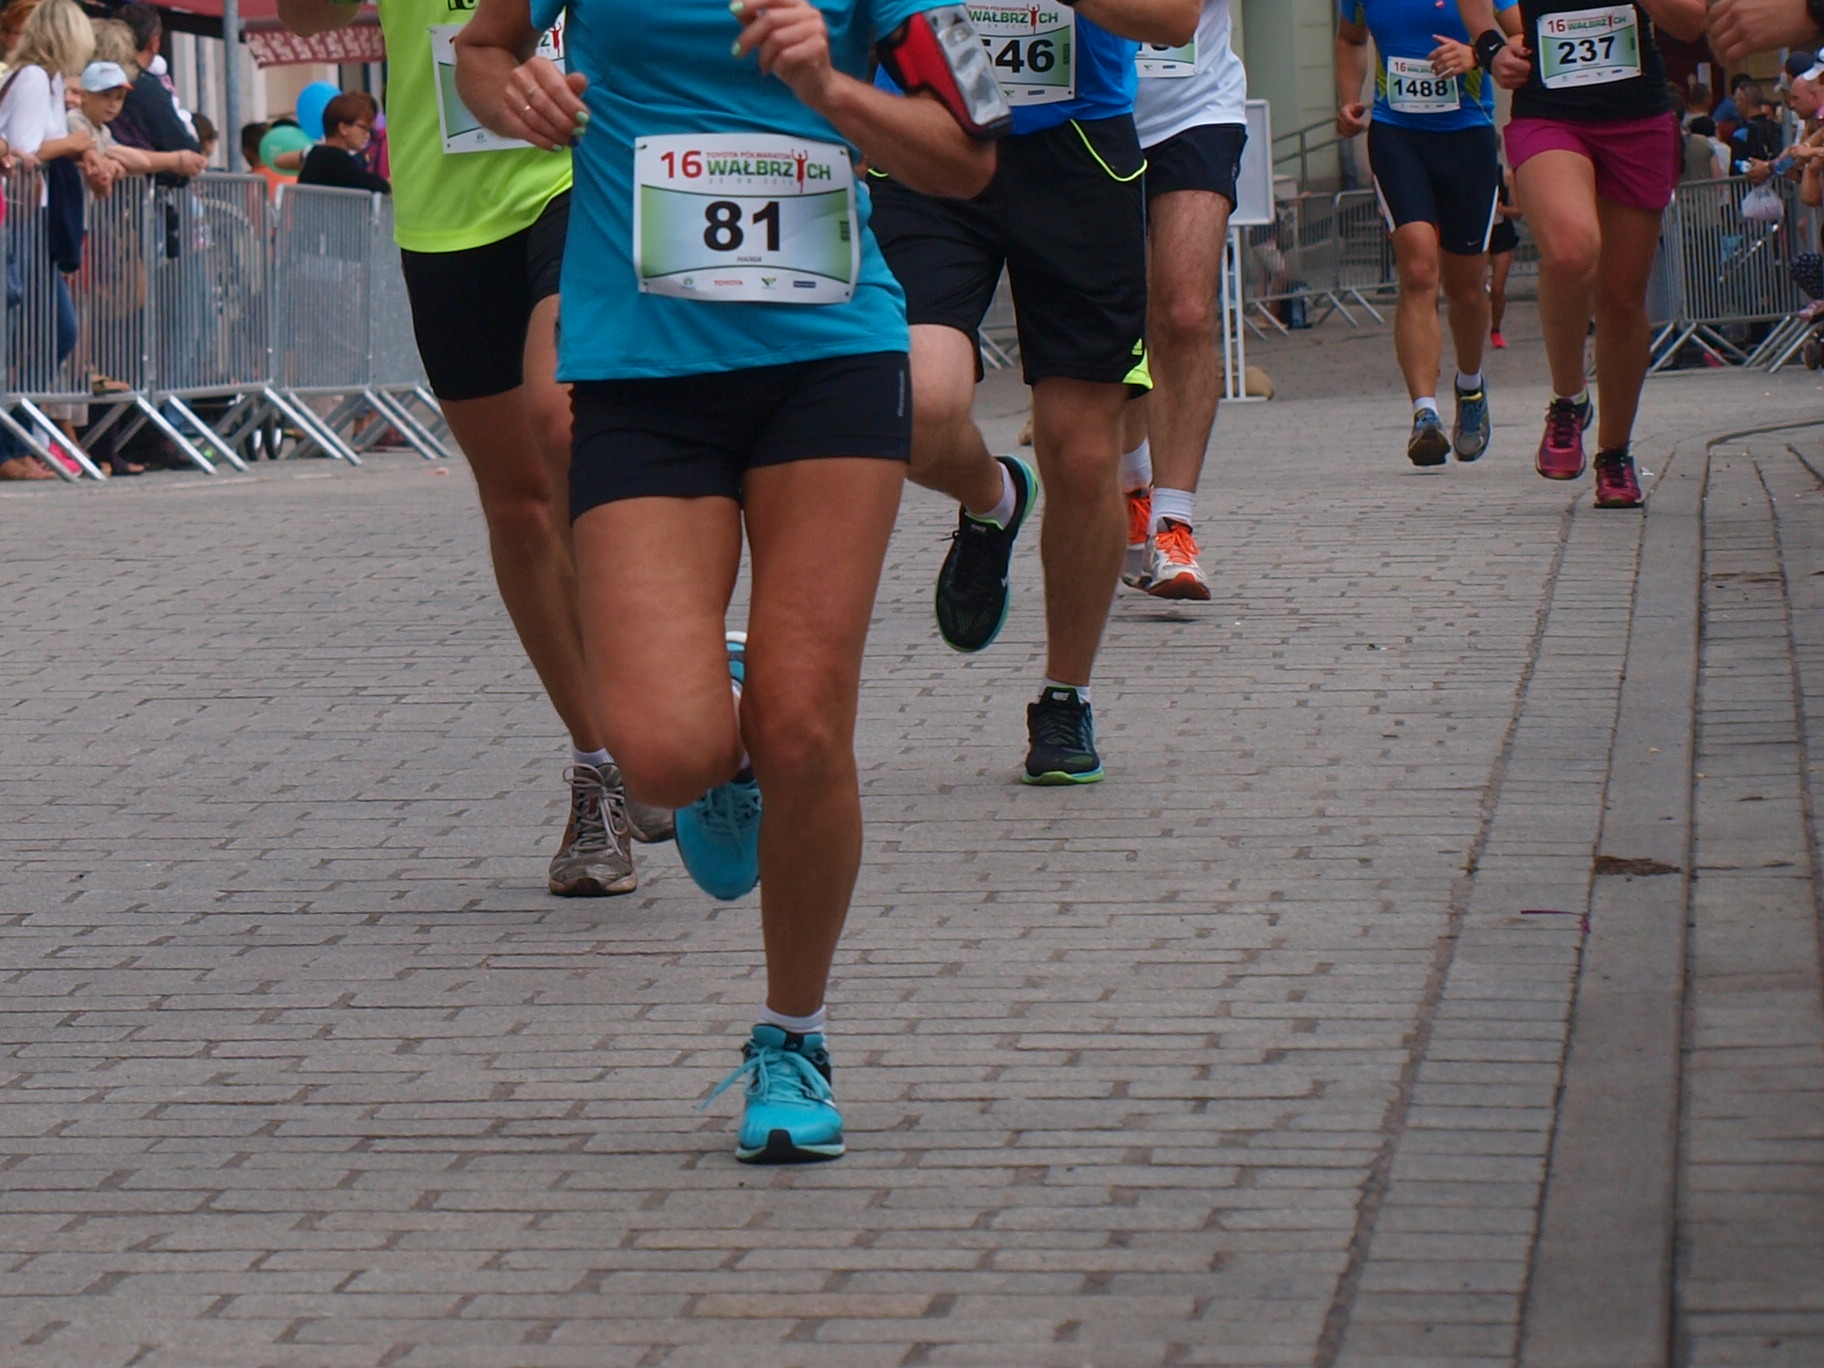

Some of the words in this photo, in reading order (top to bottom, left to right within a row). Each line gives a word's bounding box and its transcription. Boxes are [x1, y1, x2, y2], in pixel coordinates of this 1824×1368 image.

[1548, 19, 1565, 33] 16
[1558, 36, 1615, 65] 237
[1394, 62, 1406, 72] 16
[1394, 79, 1448, 97] 1488
[661, 150, 702, 178] 16
[704, 201, 780, 252] 81
